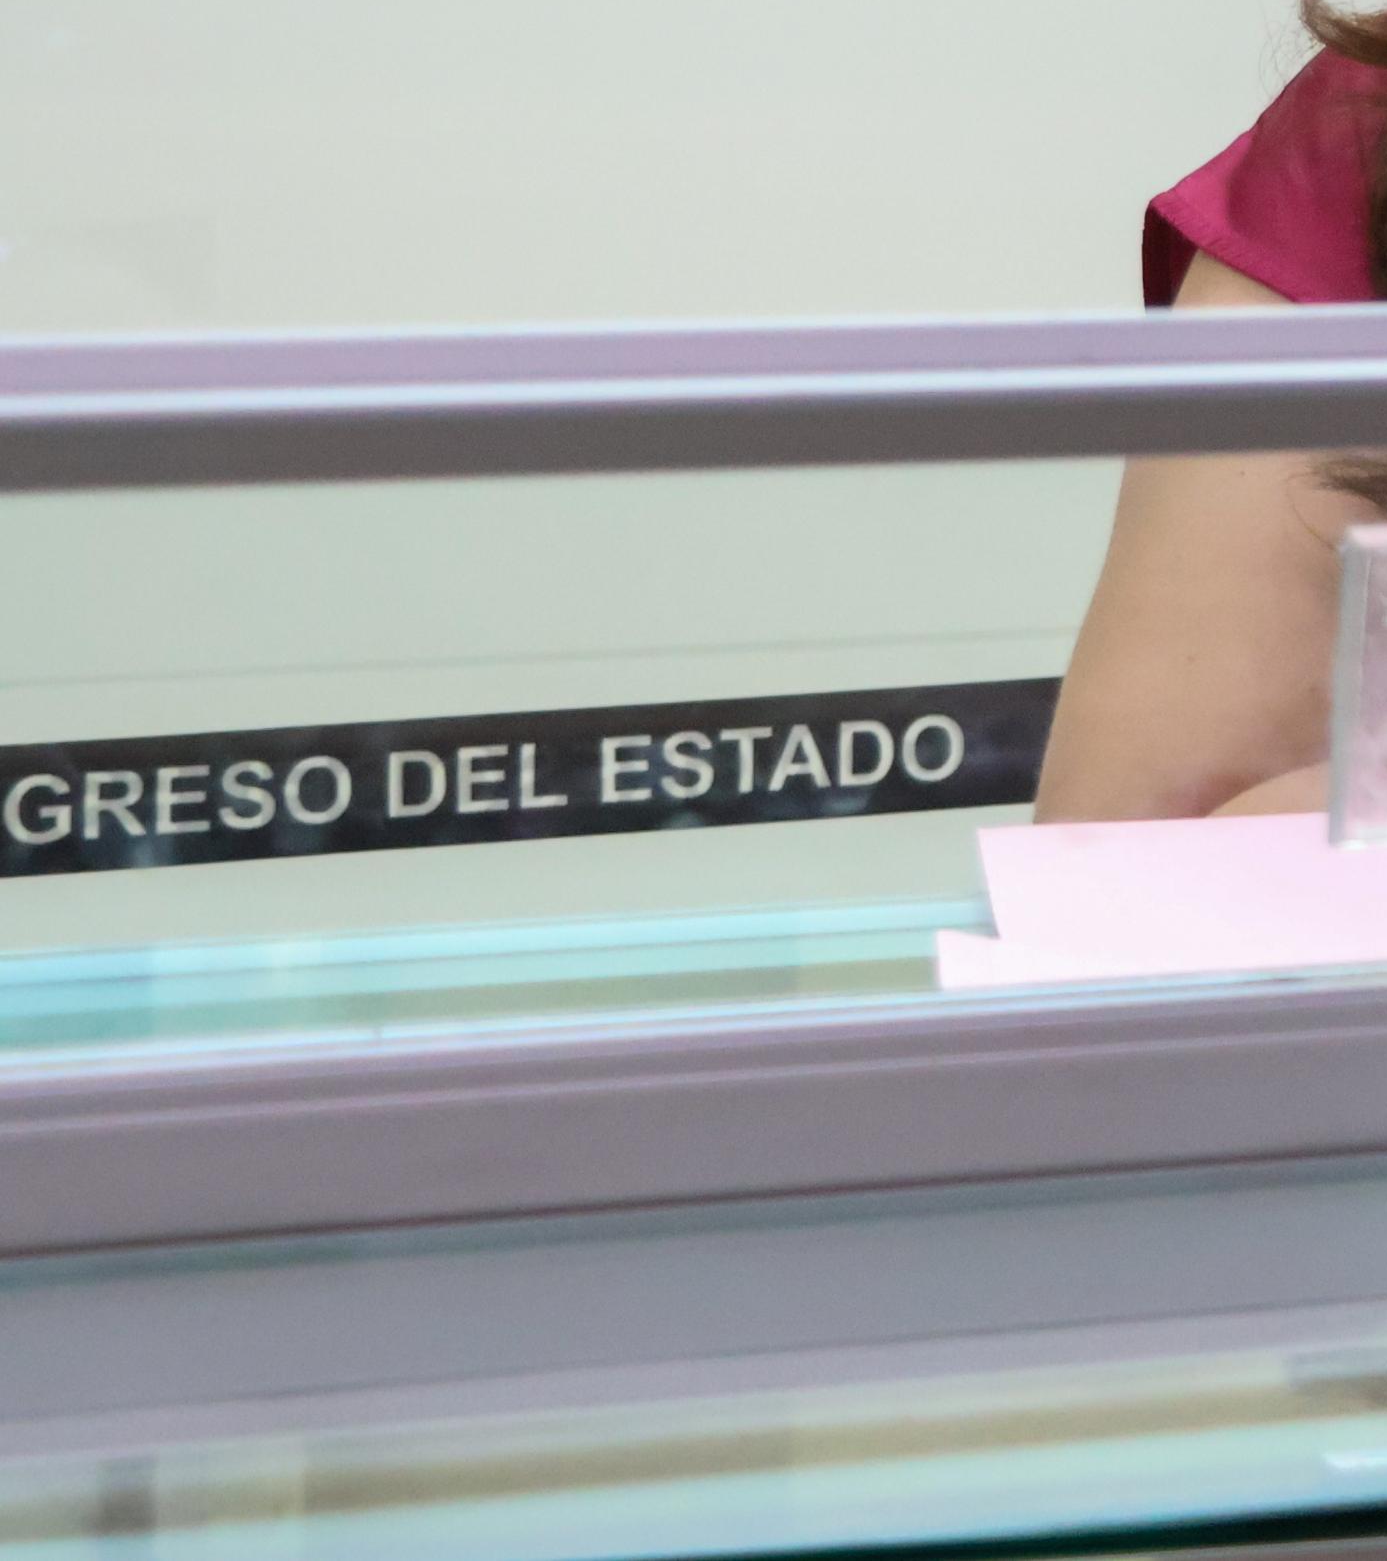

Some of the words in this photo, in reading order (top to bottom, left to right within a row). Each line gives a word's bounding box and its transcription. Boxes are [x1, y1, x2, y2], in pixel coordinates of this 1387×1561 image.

[3, 752, 353, 846] GRESO
[386, 742, 568, 820] DEL
[599, 712, 966, 806] ESTADO
